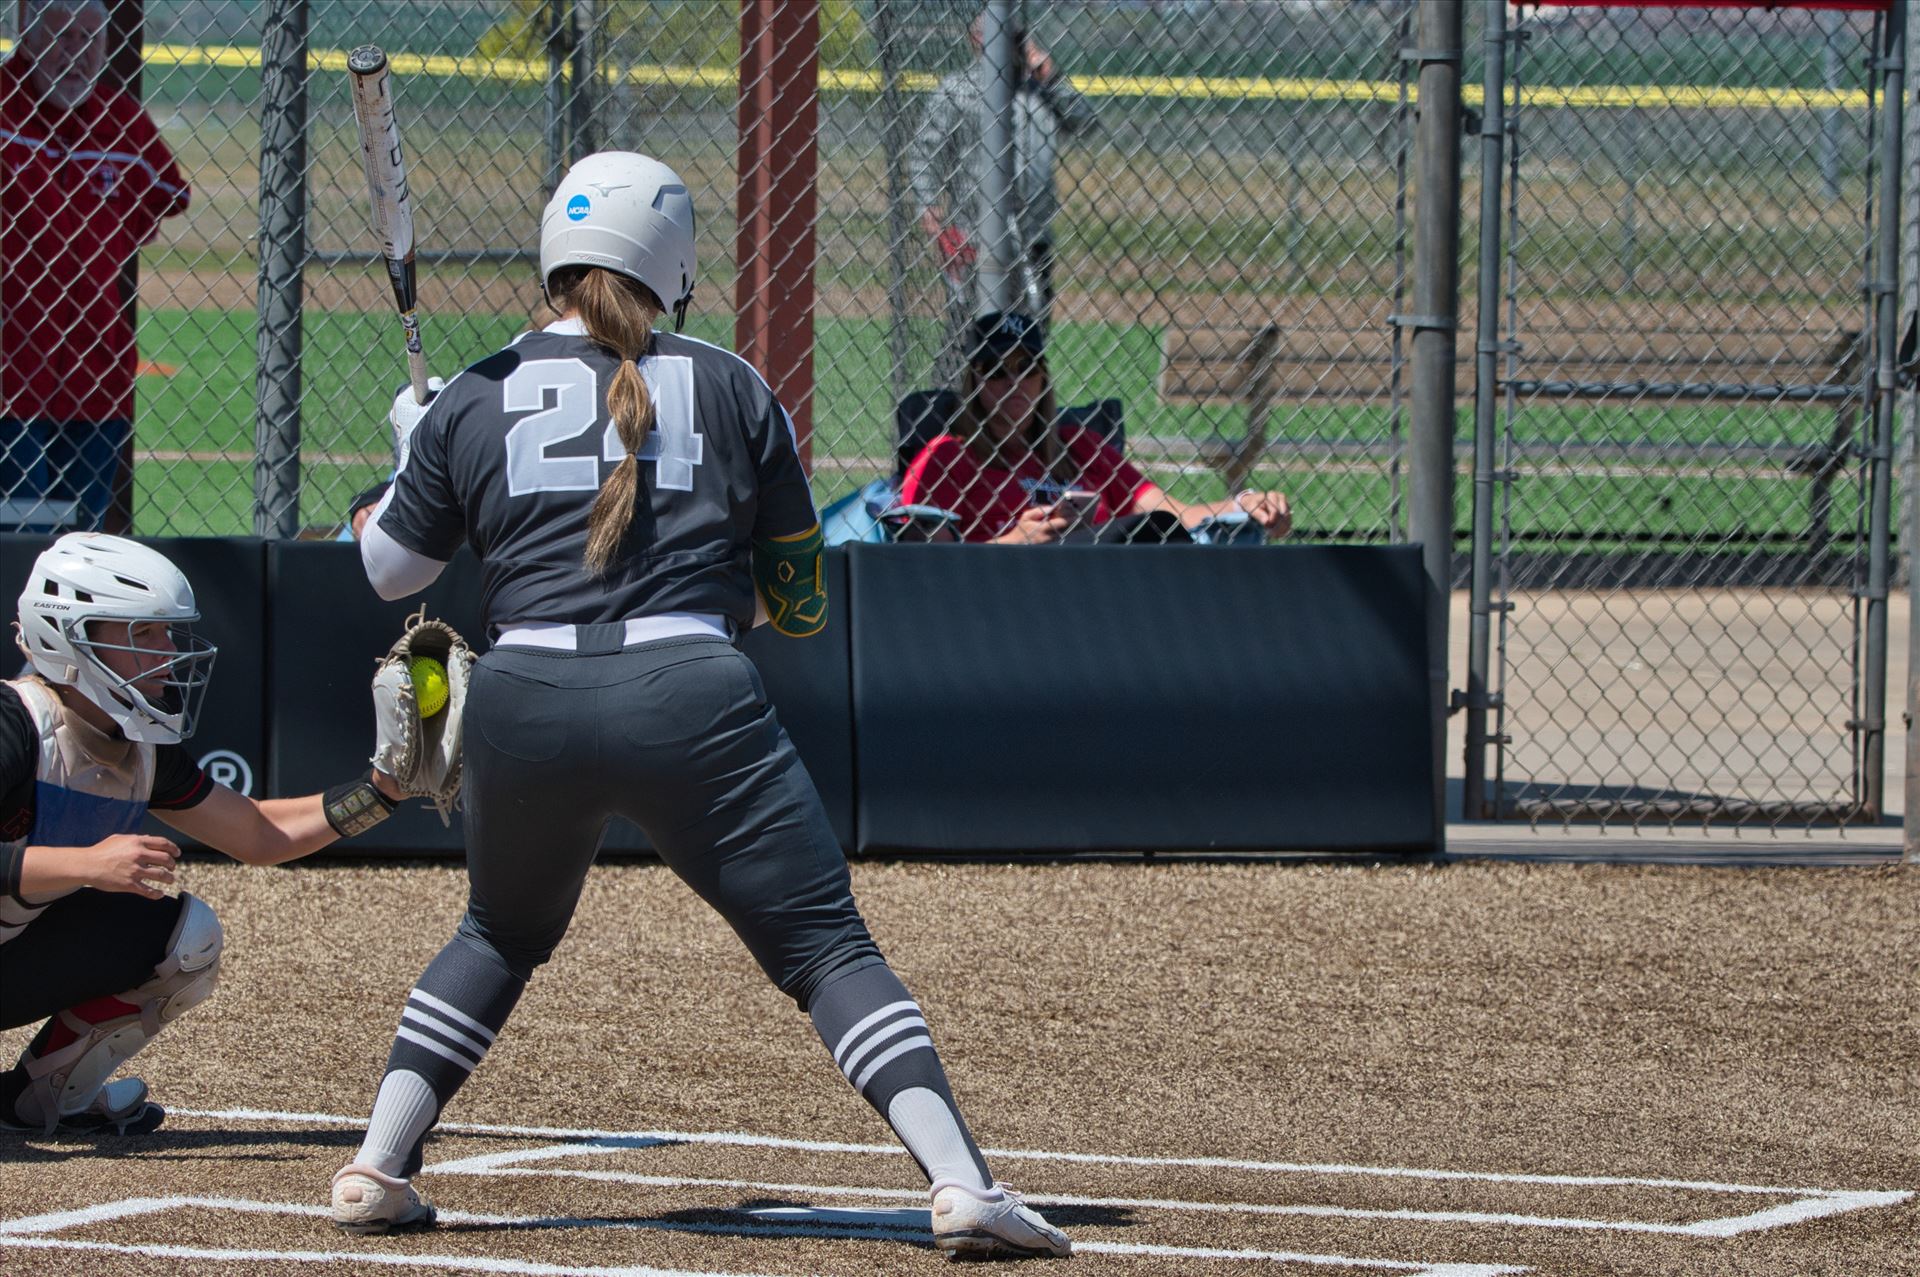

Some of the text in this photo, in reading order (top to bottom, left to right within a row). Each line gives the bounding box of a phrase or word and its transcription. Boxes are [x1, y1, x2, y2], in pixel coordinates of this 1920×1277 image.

[568, 206, 590, 216] NCAA
[503, 354, 704, 498] 24
[33, 602, 71, 611] EASTON
